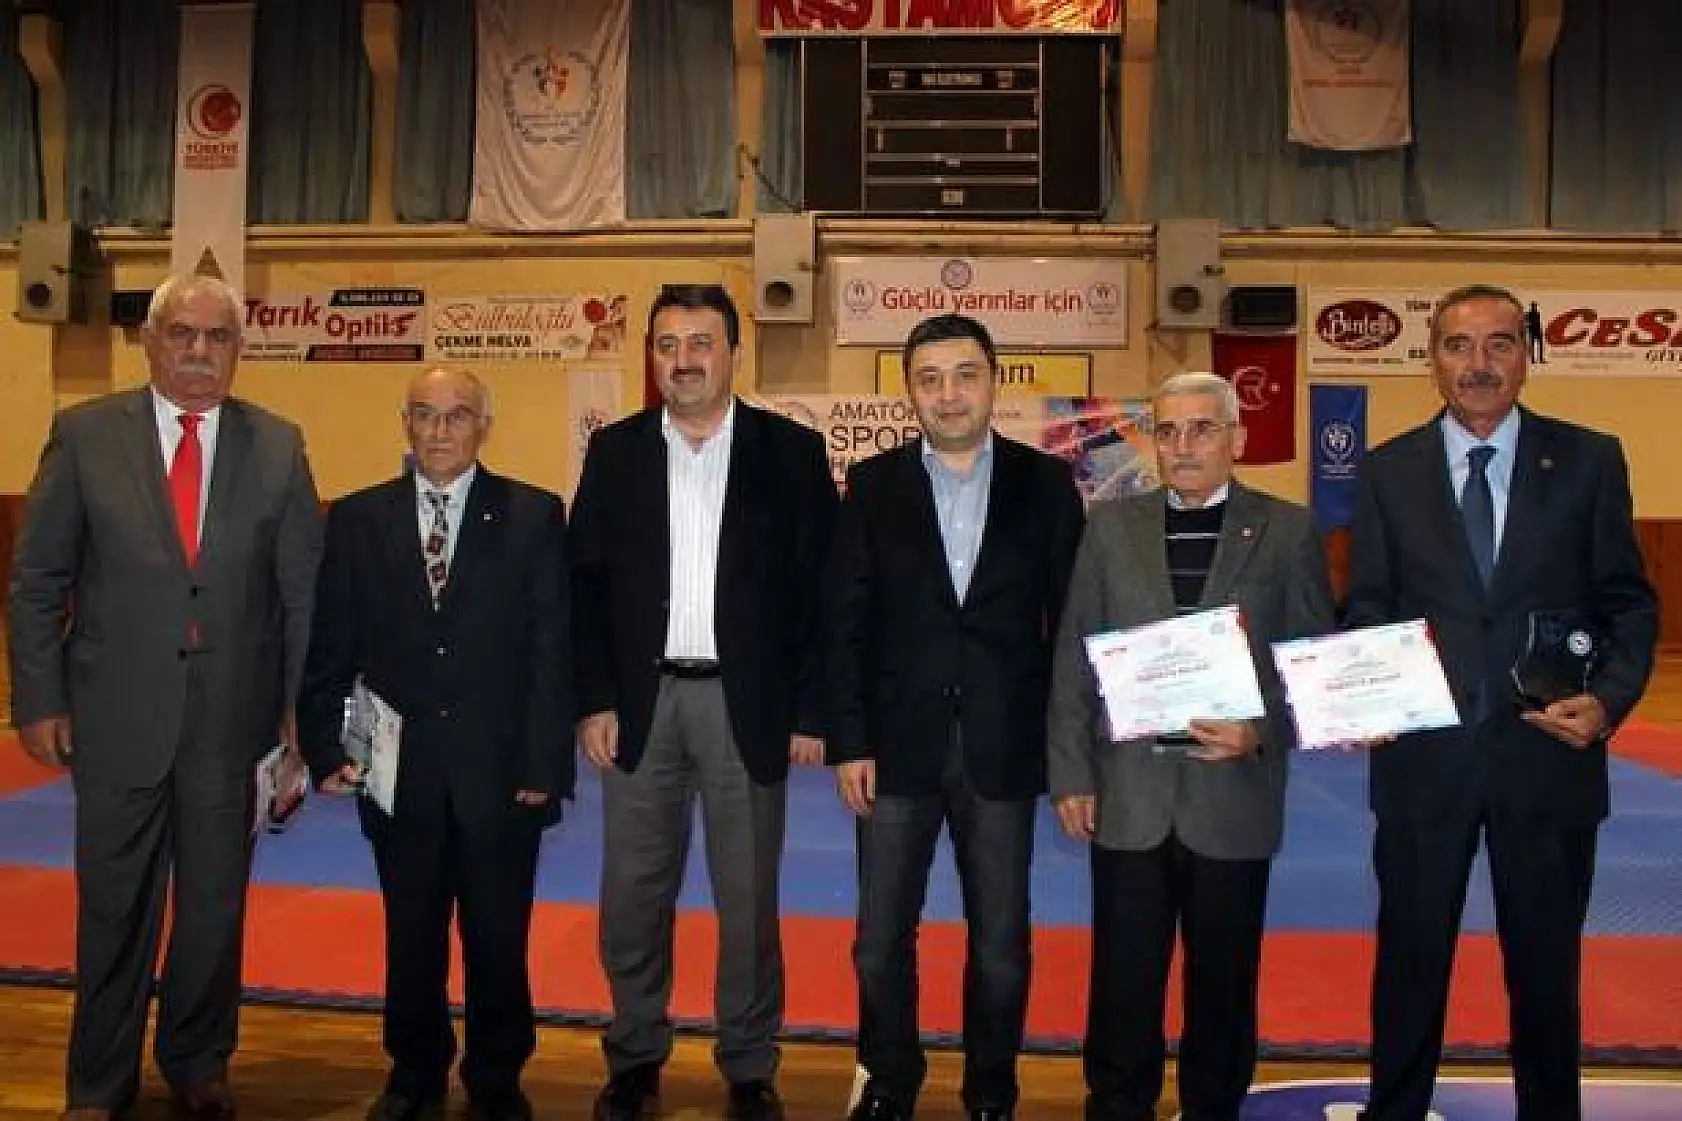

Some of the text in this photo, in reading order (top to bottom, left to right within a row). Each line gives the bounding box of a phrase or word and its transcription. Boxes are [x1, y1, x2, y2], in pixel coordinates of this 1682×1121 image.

[244, 295, 321, 328] Tarık
[882, 286, 1083, 313] Güçlü yarınlar için
